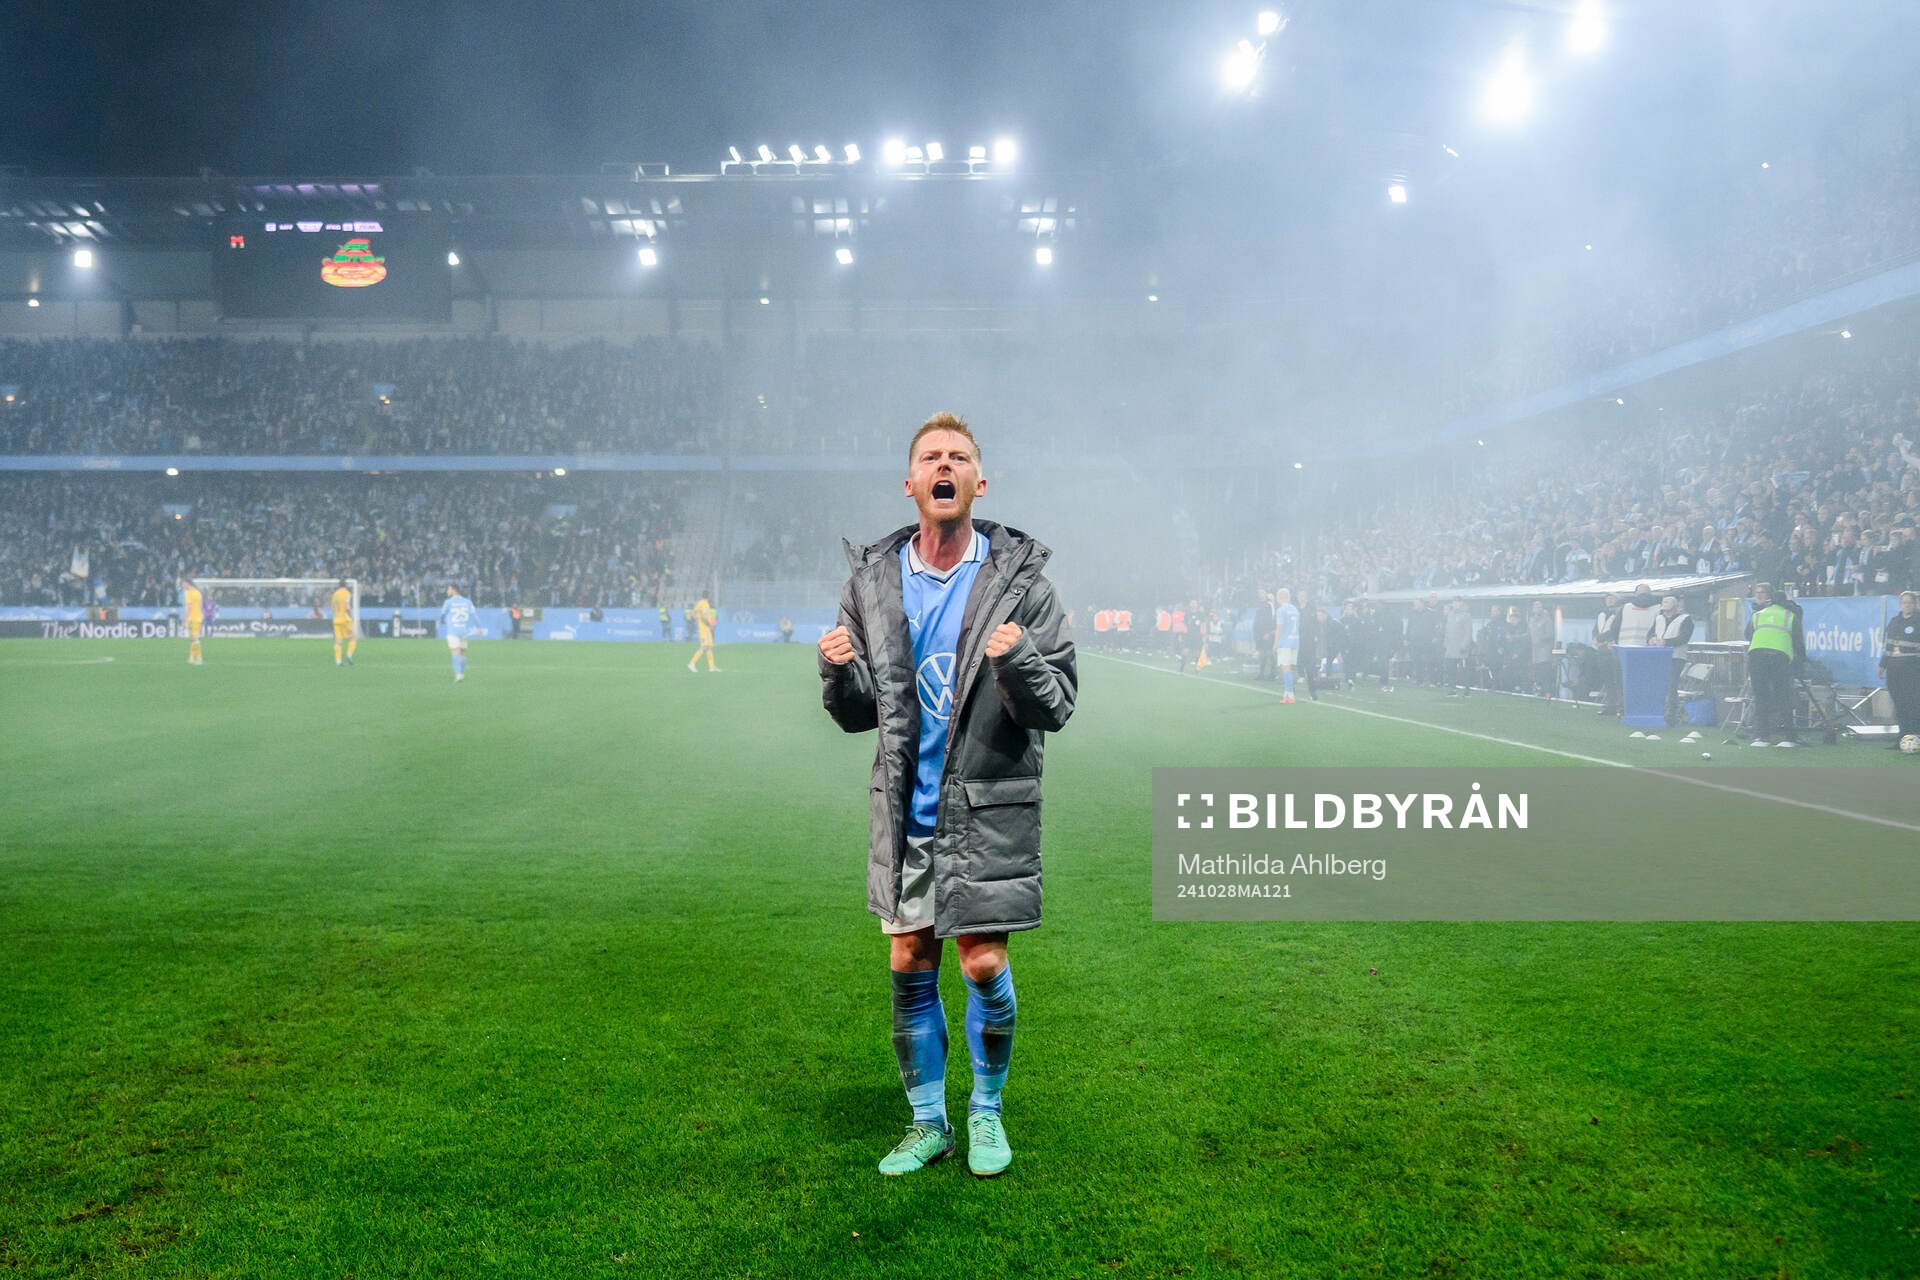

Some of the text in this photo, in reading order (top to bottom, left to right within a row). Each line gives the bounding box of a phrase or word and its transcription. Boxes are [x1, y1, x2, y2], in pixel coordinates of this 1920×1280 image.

[450, 607, 470, 624] 25
[41, 620, 78, 638] The
[80, 622, 139, 638] Nordic
